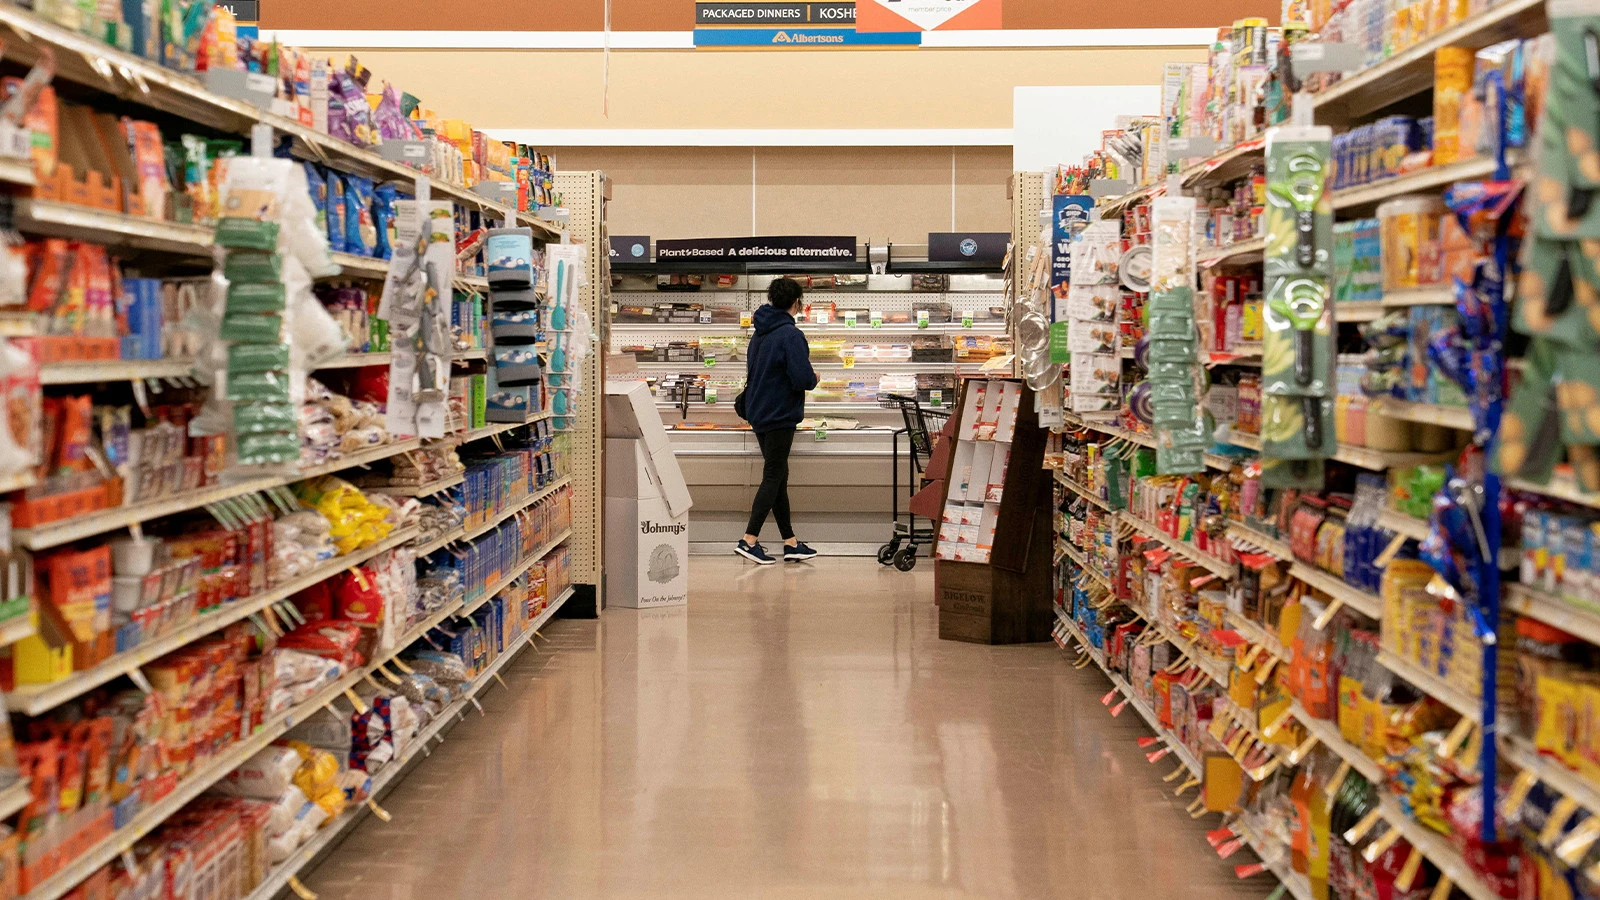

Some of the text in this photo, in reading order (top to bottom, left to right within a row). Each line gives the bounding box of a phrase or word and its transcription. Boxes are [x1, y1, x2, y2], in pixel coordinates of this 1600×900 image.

[702, 8, 755, 18] PACKAGED
[757, 8, 801, 18] DINNERS
[936, 6, 952, 14] price
[791, 33, 844, 43] Albertsons
[659, 246, 853, 257] Plant Based A delicious alternative.
[641, 520, 686, 535] Johnny's
[943, 591, 985, 603] BIGELOW
